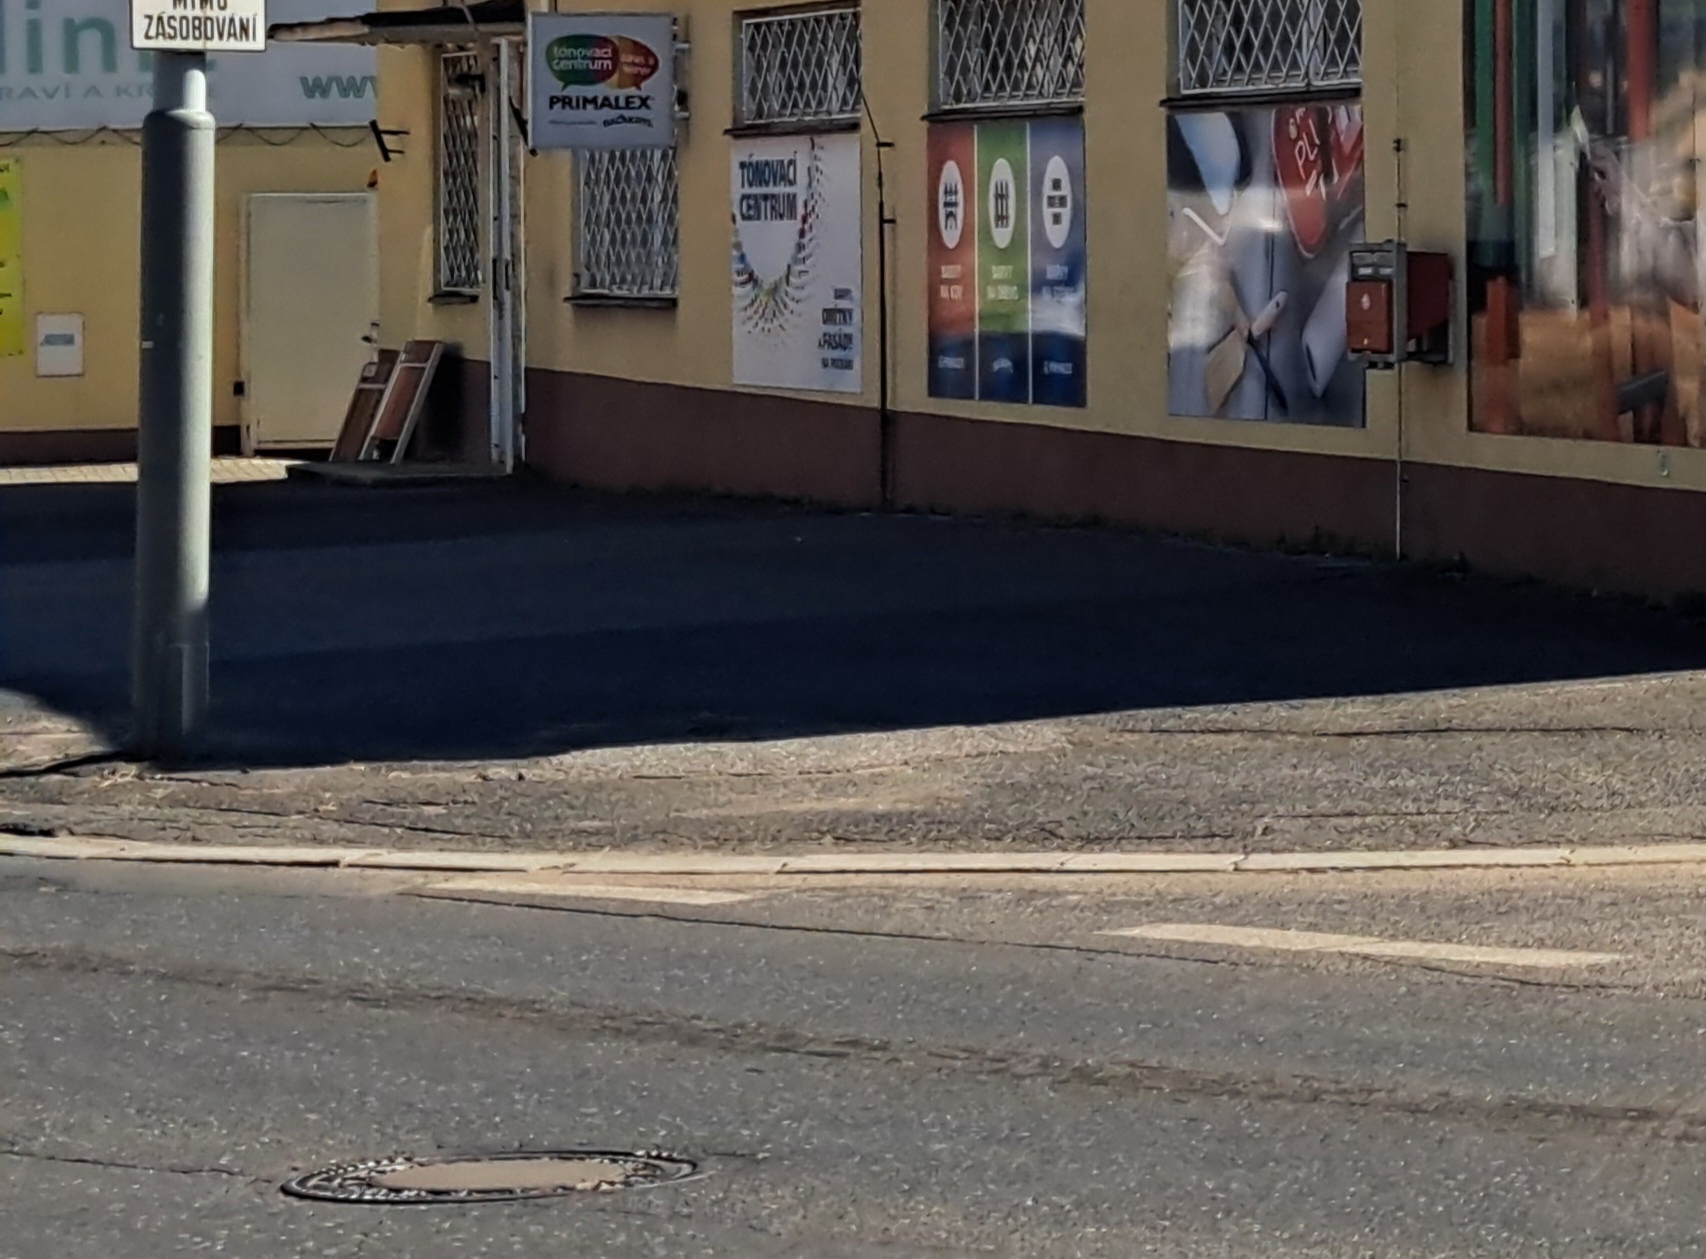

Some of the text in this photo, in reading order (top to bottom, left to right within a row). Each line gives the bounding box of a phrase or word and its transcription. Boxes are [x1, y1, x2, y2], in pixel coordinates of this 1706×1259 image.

[143, 11, 259, 42] ZÁSOBOVÁNÍ
[549, 95, 652, 110] PRIMALEX
[739, 150, 798, 189] TÓNOVACÍ
[739, 192, 798, 222] CENTRUM
